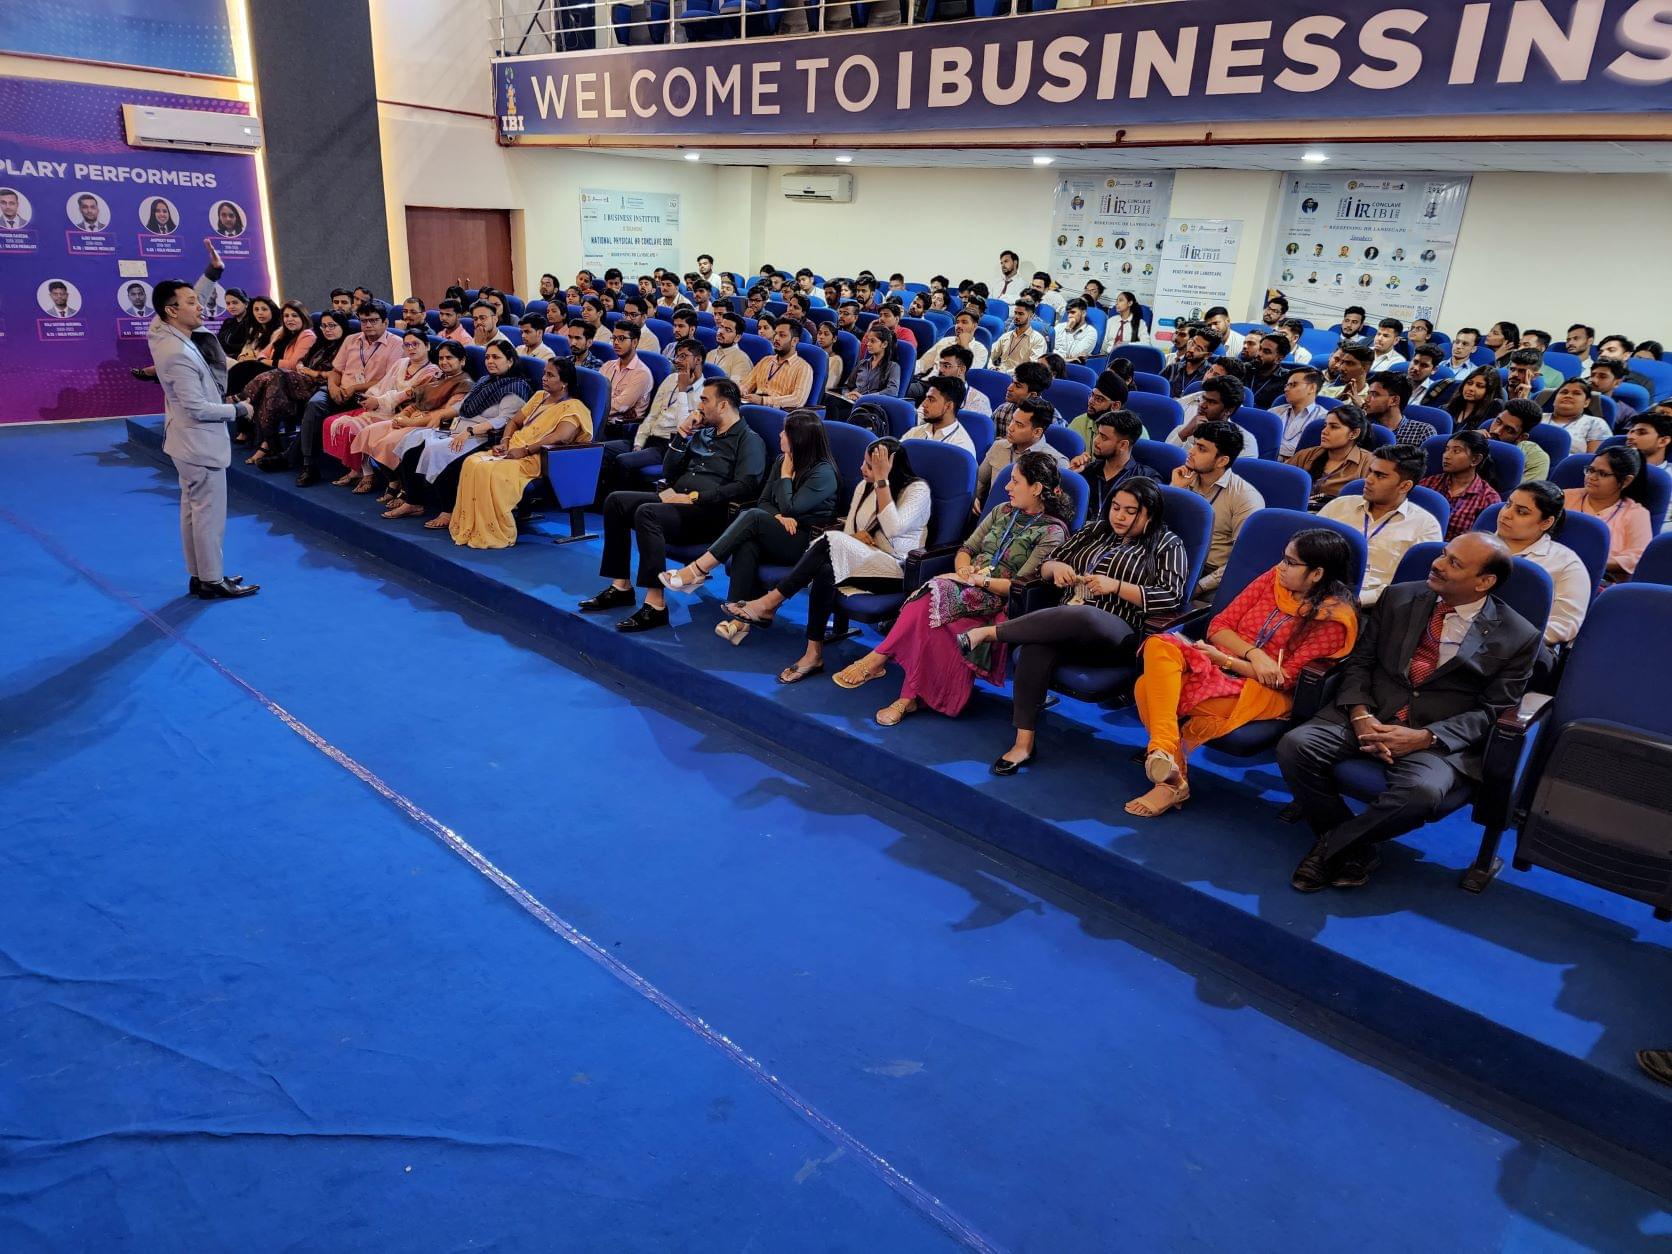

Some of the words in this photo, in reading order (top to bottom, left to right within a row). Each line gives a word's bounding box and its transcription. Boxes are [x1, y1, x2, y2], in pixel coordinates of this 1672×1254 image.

[530, 62, 781, 120] WELCOME
[796, 54, 880, 113] TO
[896, 50, 912, 110] I
[927, 8, 1429, 108] BUSINESS
[1447, 0, 1672, 85] INS
[501, 115, 525, 131] IBI
[74, 163, 217, 188] PERFORMERS
[607, 214, 632, 222] BUSINESS
[633, 215, 661, 223] INSTITUTE
[1373, 208, 1394, 219] IBI
[591, 236, 612, 245] NATIONAL
[613, 237, 633, 245] PHYSICAL
[641, 238, 662, 246] CONCLAVE
